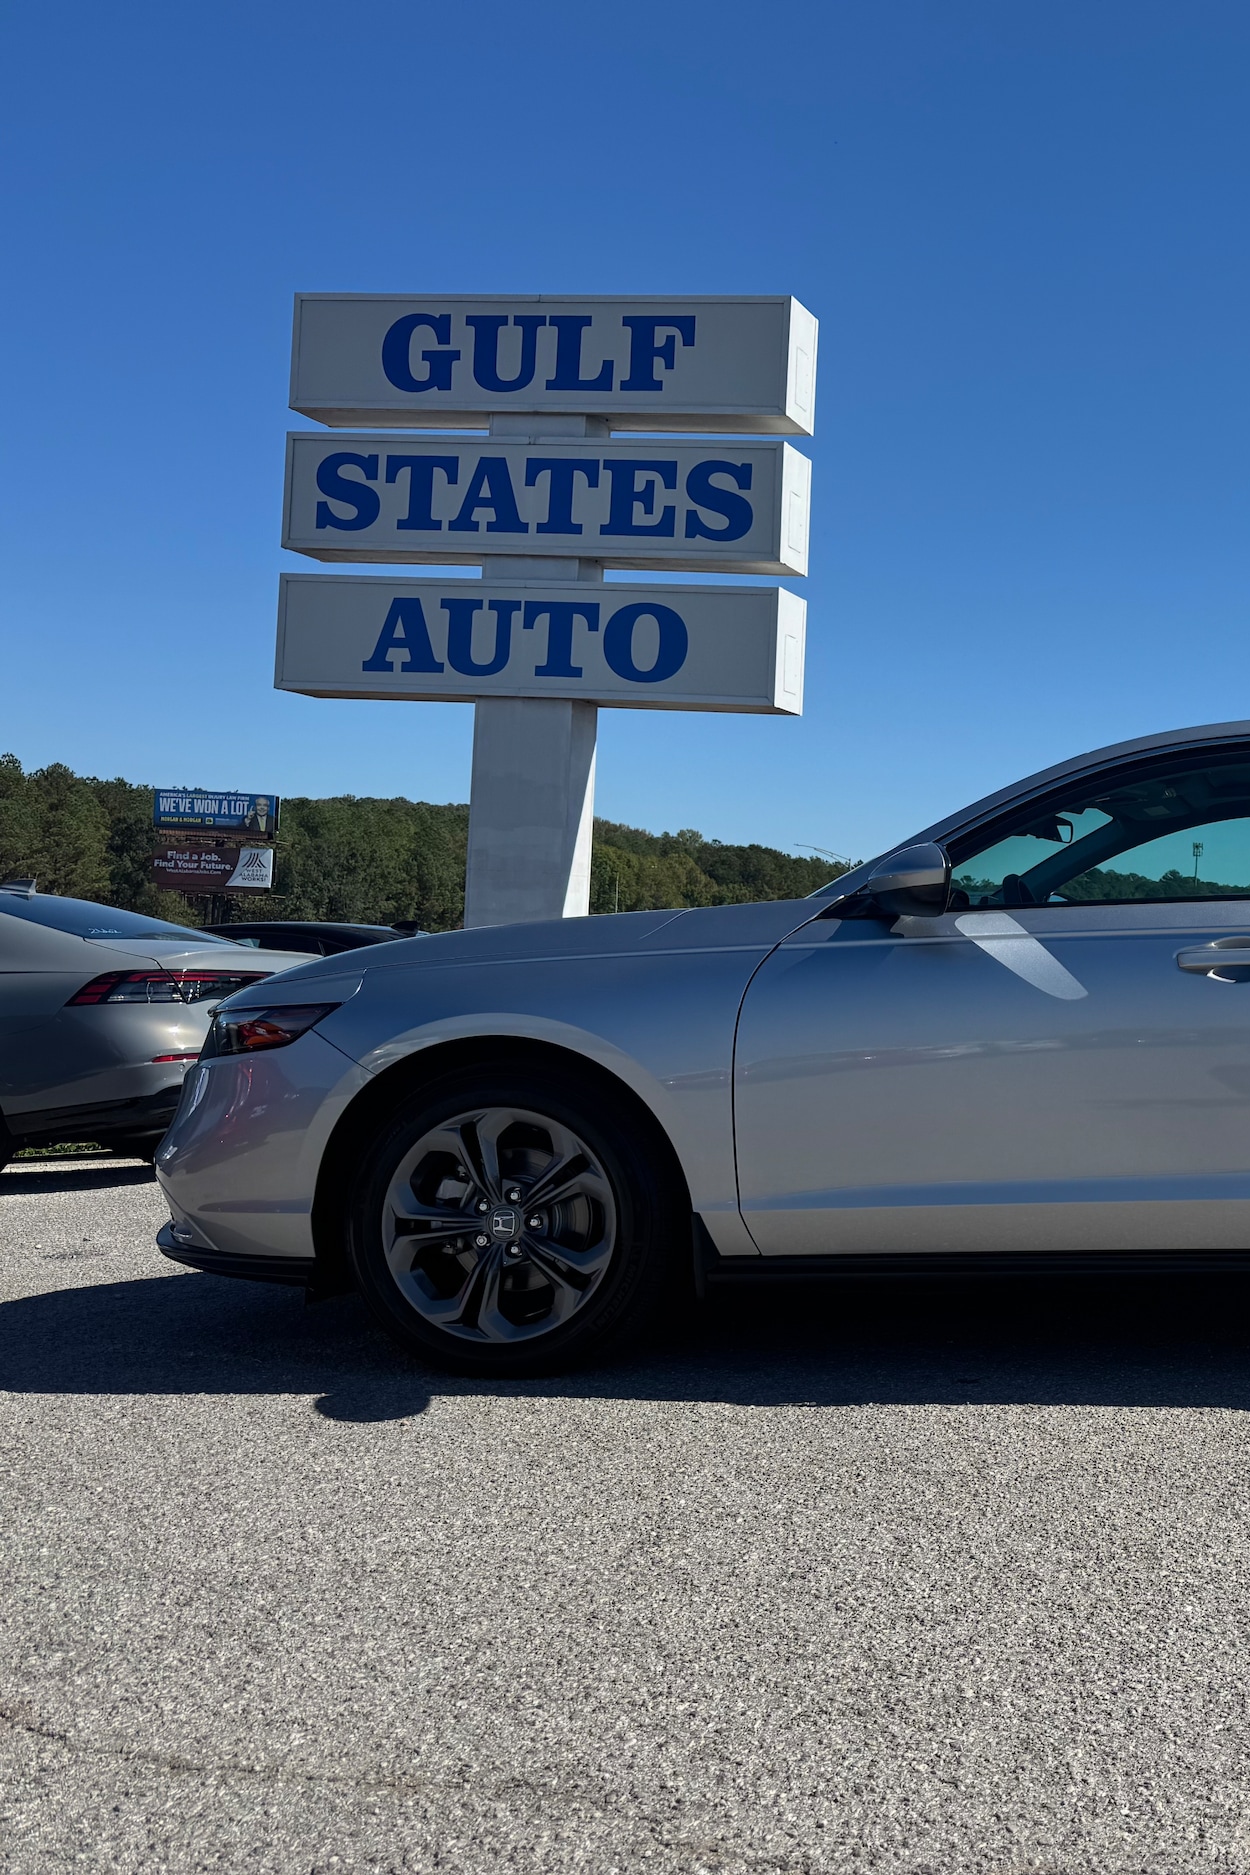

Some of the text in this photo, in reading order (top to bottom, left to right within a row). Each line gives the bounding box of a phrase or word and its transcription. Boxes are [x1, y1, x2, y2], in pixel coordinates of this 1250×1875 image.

[381, 313, 696, 393] GULF
[315, 452, 753, 542] STATES
[362, 597, 689, 684] AUTO
[160, 797, 249, 816] WE'VE WON A LOT
[154, 859, 234, 870] Find Your Future.
[167, 851, 190, 860] Find
[201, 852, 222, 862] Job.
